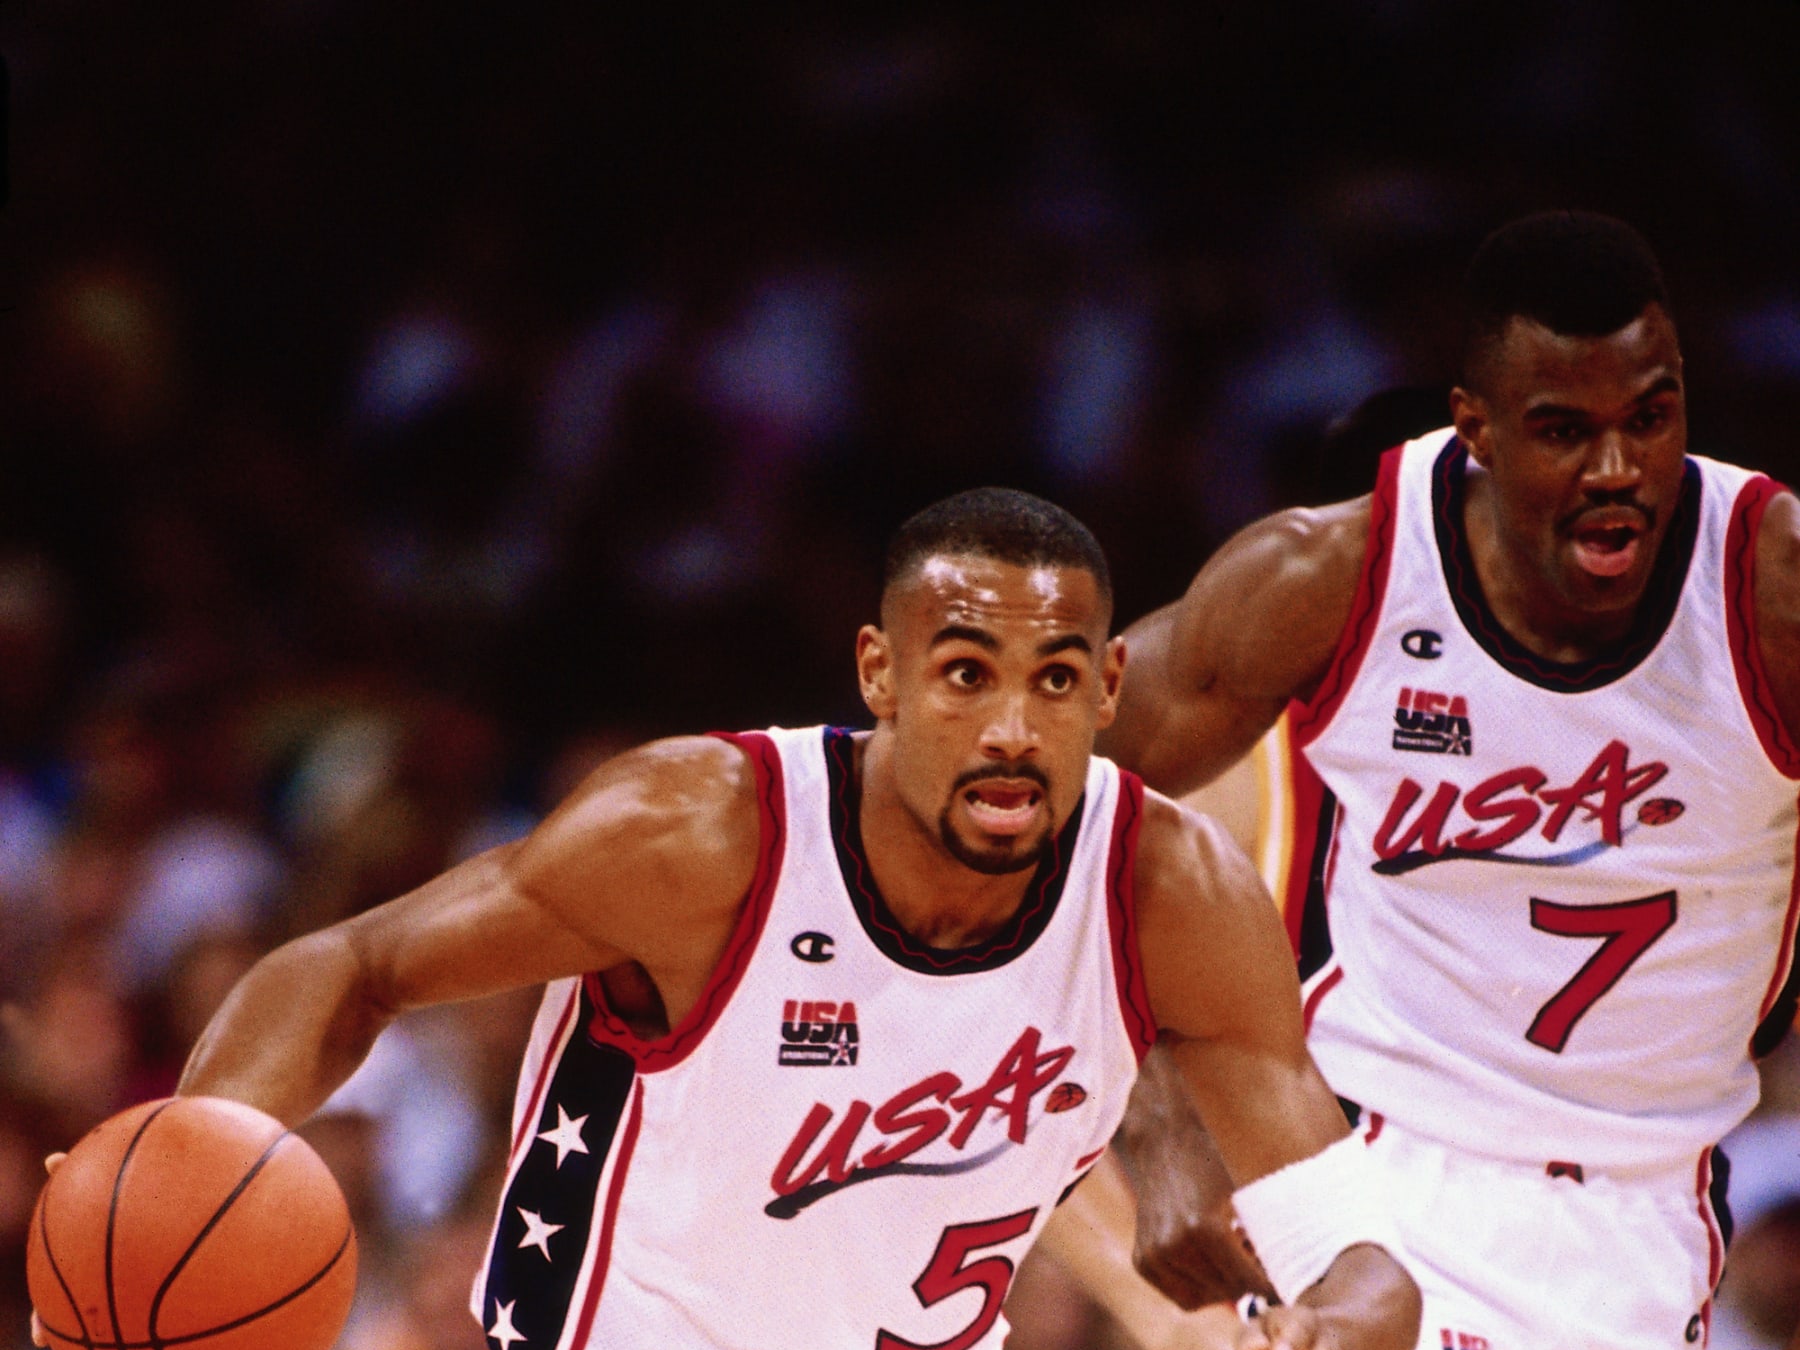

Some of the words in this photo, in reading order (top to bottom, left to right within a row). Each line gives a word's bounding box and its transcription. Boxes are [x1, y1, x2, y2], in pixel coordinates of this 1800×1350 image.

[1395, 687, 1471, 737] USA
[1373, 739, 1669, 860] USA
[781, 999, 859, 1043] USA
[1525, 890, 1678, 1054] 7
[770, 1026, 1076, 1196] USA
